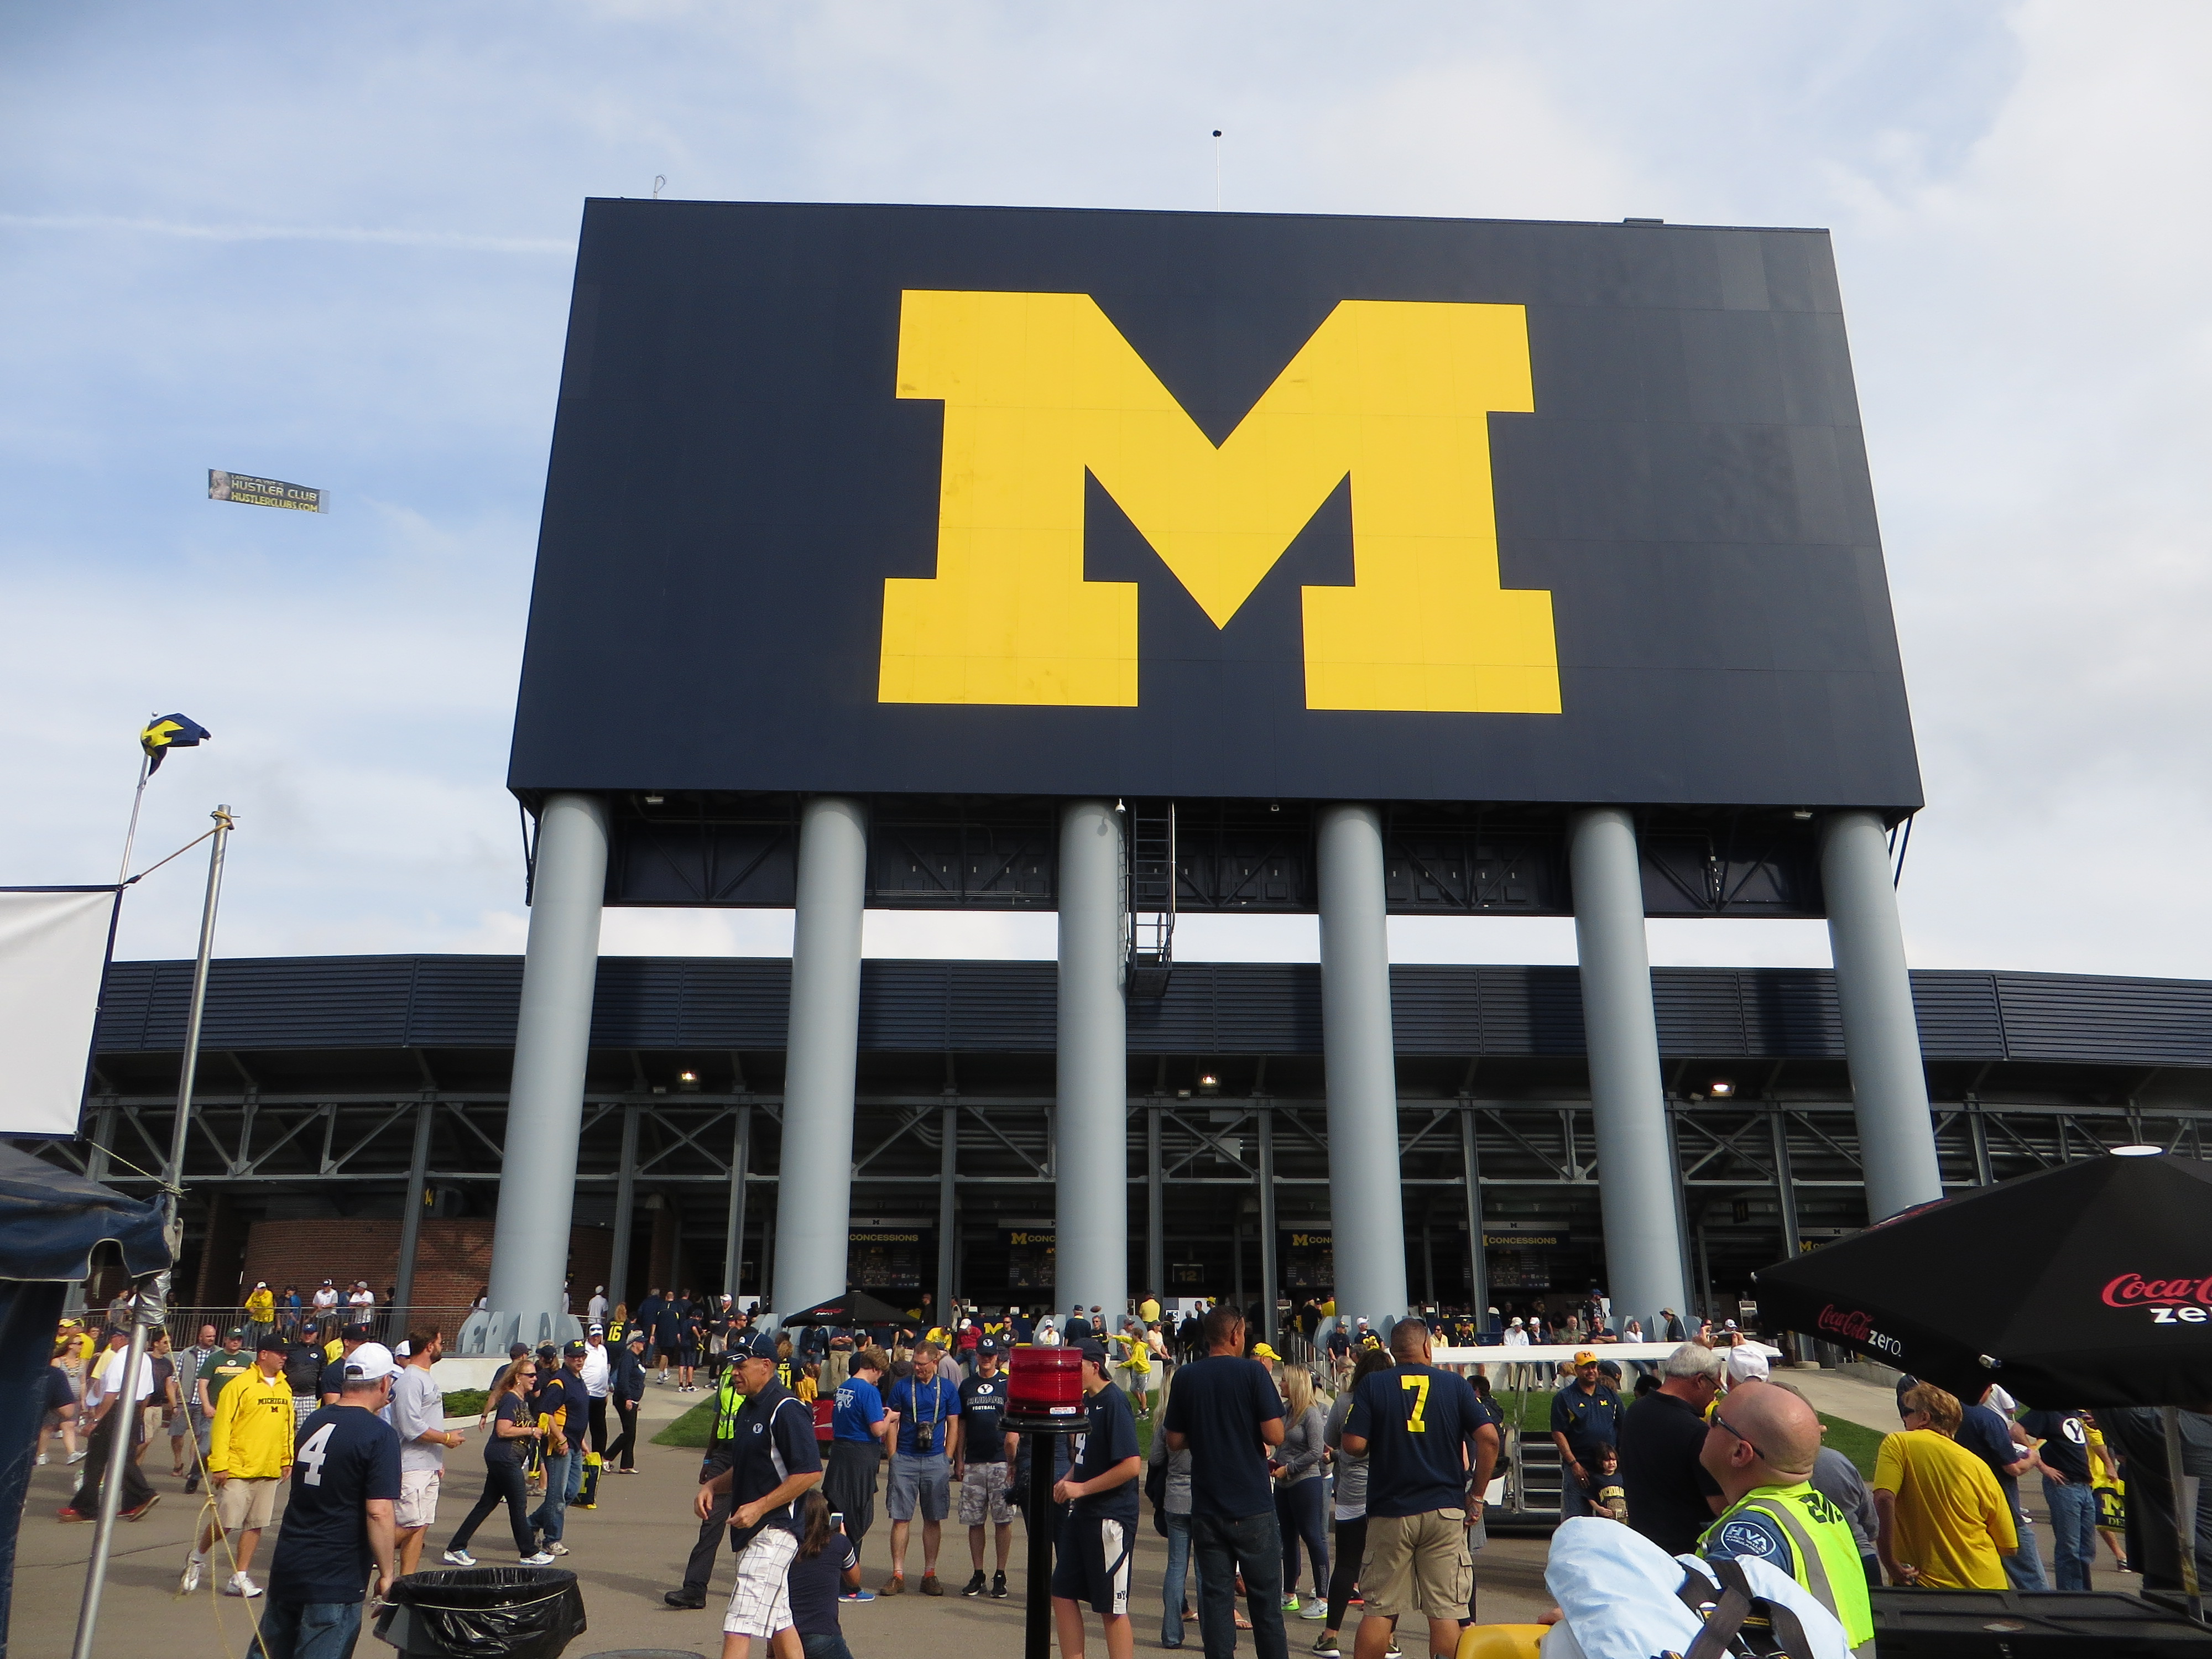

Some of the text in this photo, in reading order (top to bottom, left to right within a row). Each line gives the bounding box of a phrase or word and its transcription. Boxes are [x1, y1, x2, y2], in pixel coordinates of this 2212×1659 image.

[231, 480, 317, 502] HUSTLER CLUB
[231, 492, 318, 512] HUSTLERCLUBS.COM
[878, 290, 1562, 714] M
[425, 1188, 434, 1206] 14
[1011, 1233, 1027, 1244] M
[1292, 1234, 1308, 1246] M
[1179, 1270, 1197, 1281] 12
[1818, 1304, 1875, 1340] Coca-Cola
[2150, 1307, 2212, 1323] ze
[607, 1326, 623, 1342] 16
[1401, 1375, 1430, 1432] 7
[297, 1422, 337, 1486] 4
[1726, 1525, 1767, 1552] HVA
[1117, 1590, 1128, 1600] BY
